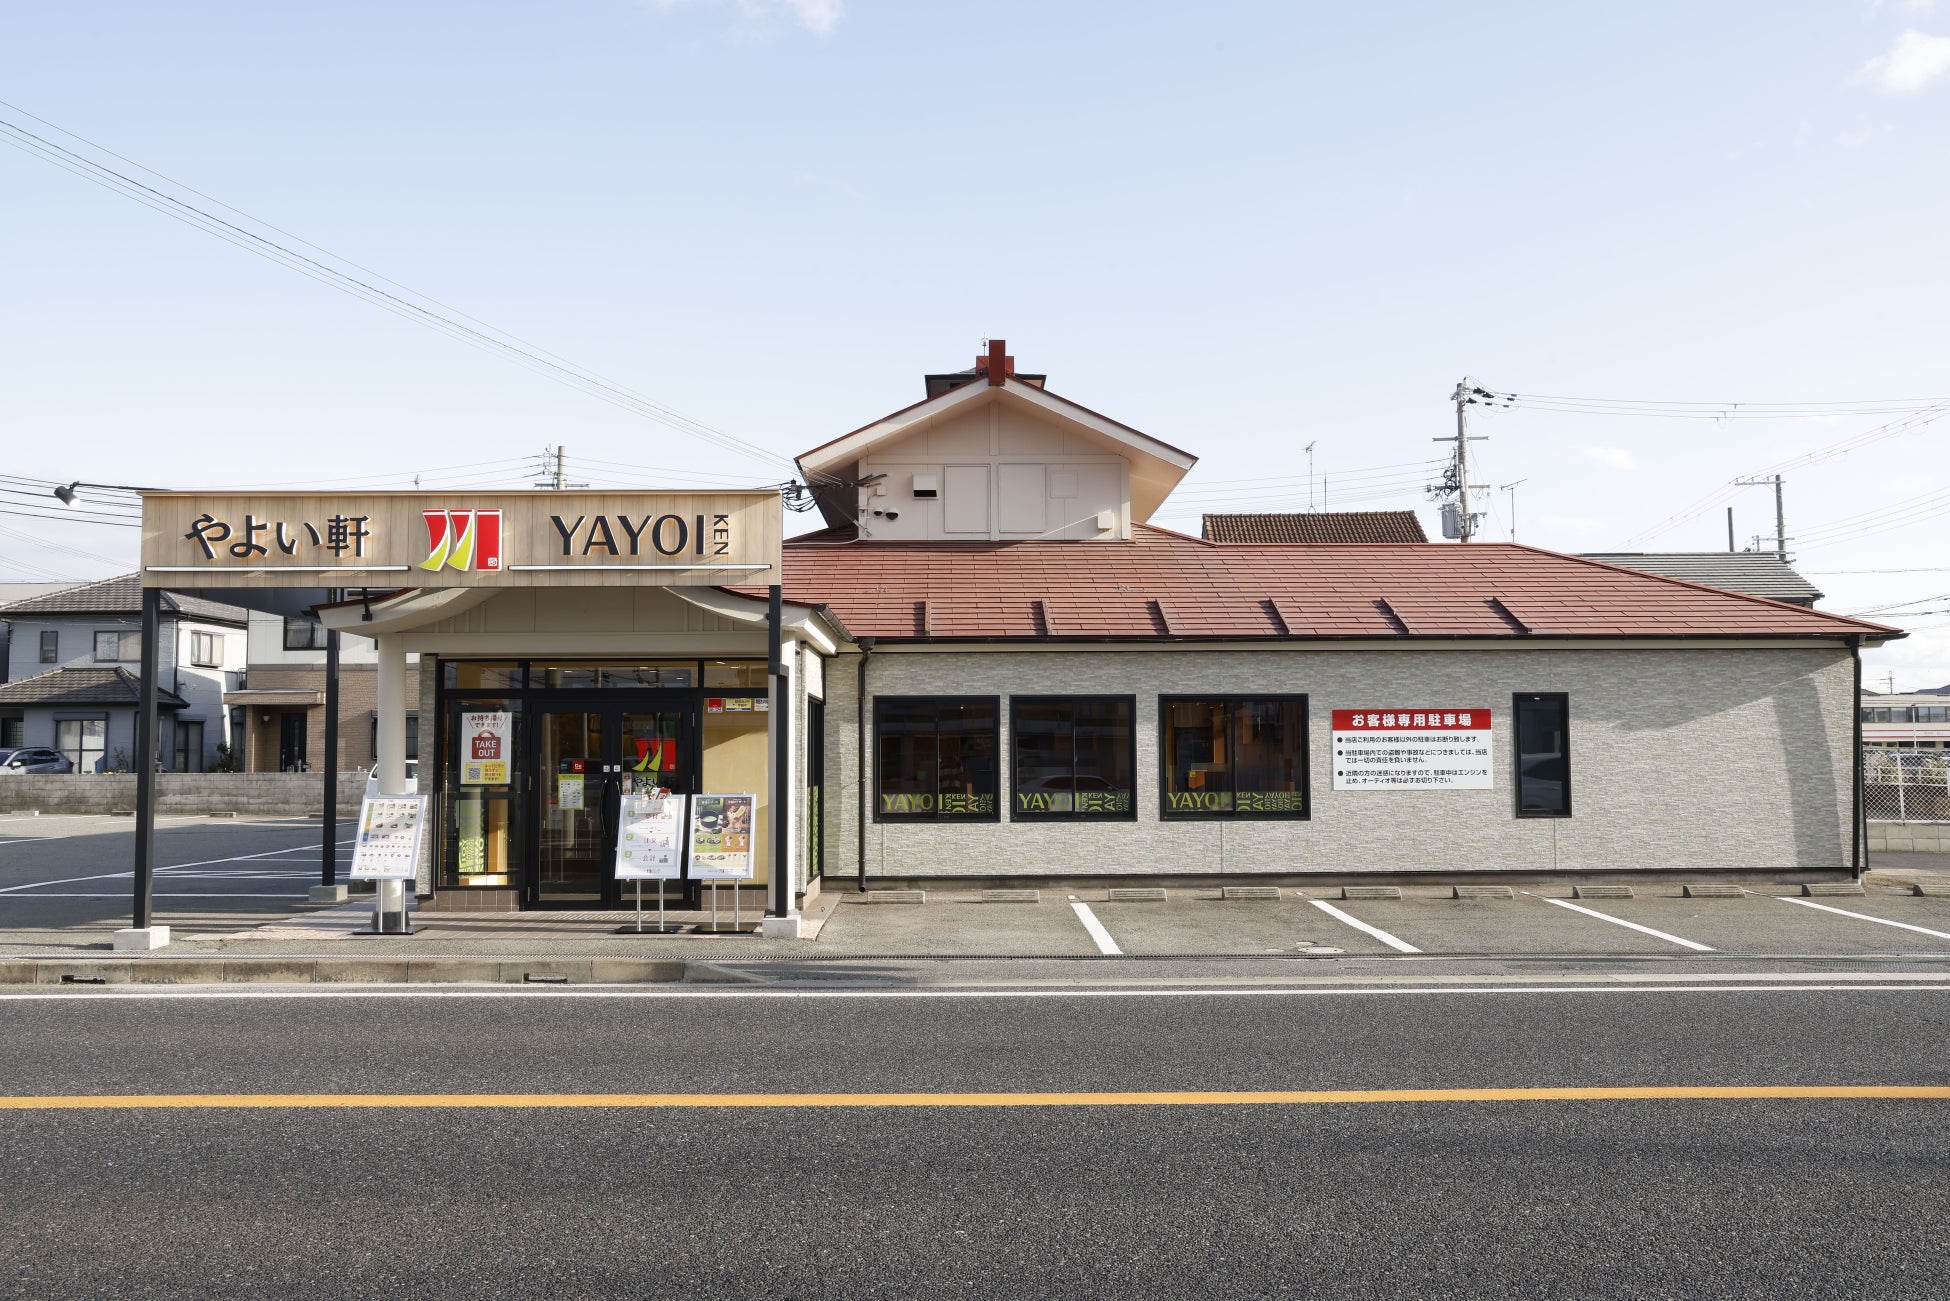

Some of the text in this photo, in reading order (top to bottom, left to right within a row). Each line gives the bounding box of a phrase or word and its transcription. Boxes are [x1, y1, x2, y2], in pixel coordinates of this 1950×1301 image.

[184, 513, 371, 560] やよい軒
[550, 514, 705, 556] YAYOI
[713, 514, 729, 555] KEN
[1352, 713, 1472, 727] お客様専用駐車場
[474, 740, 497, 748] TAKE
[478, 749, 496, 757] OUT
[882, 793, 943, 810] YAYOI
[1019, 792, 1080, 809] YAYOI
